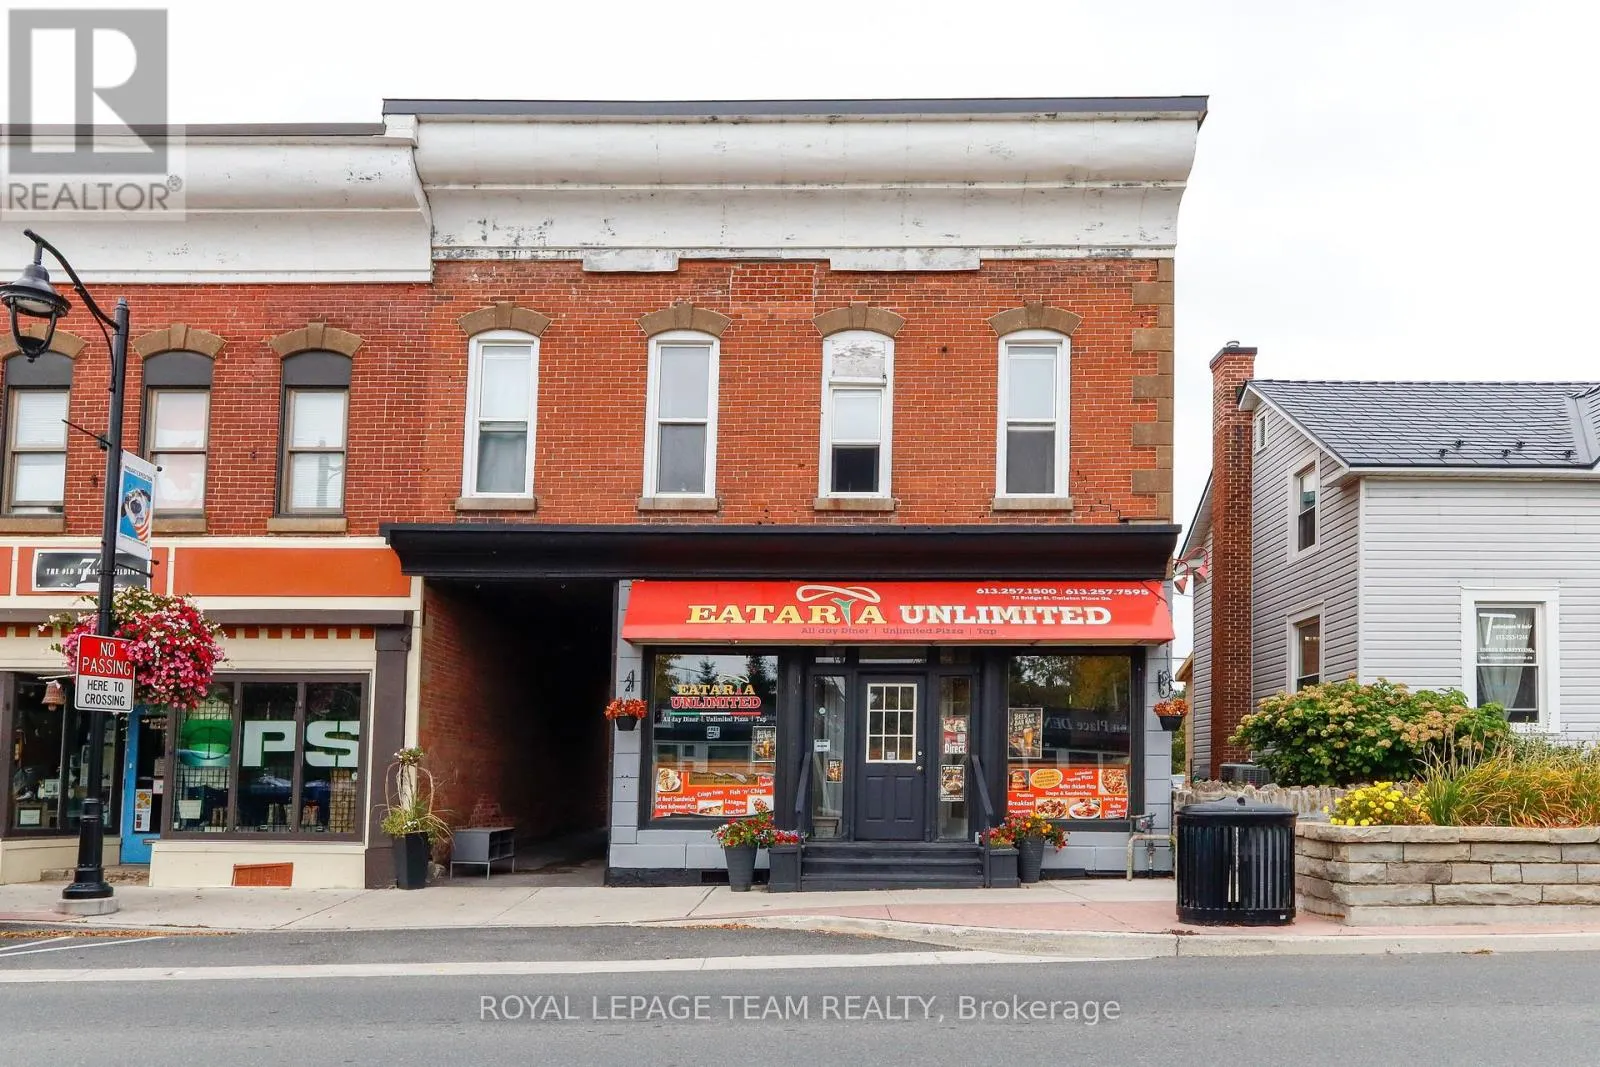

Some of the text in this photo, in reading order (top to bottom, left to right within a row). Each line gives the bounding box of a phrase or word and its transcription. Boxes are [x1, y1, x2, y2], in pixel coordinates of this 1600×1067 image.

[1065, 588, 1149, 596] 613.257.7595
[900, 605, 1112, 625] UNLIMITED
[818, 627, 838, 635] day
[100, 642, 115, 657] NO
[82, 656, 131, 676] PASSING
[87, 679, 124, 692] HERE TO
[85, 693, 125, 706] CROSSING
[670, 696, 761, 709] UNLIMITED
